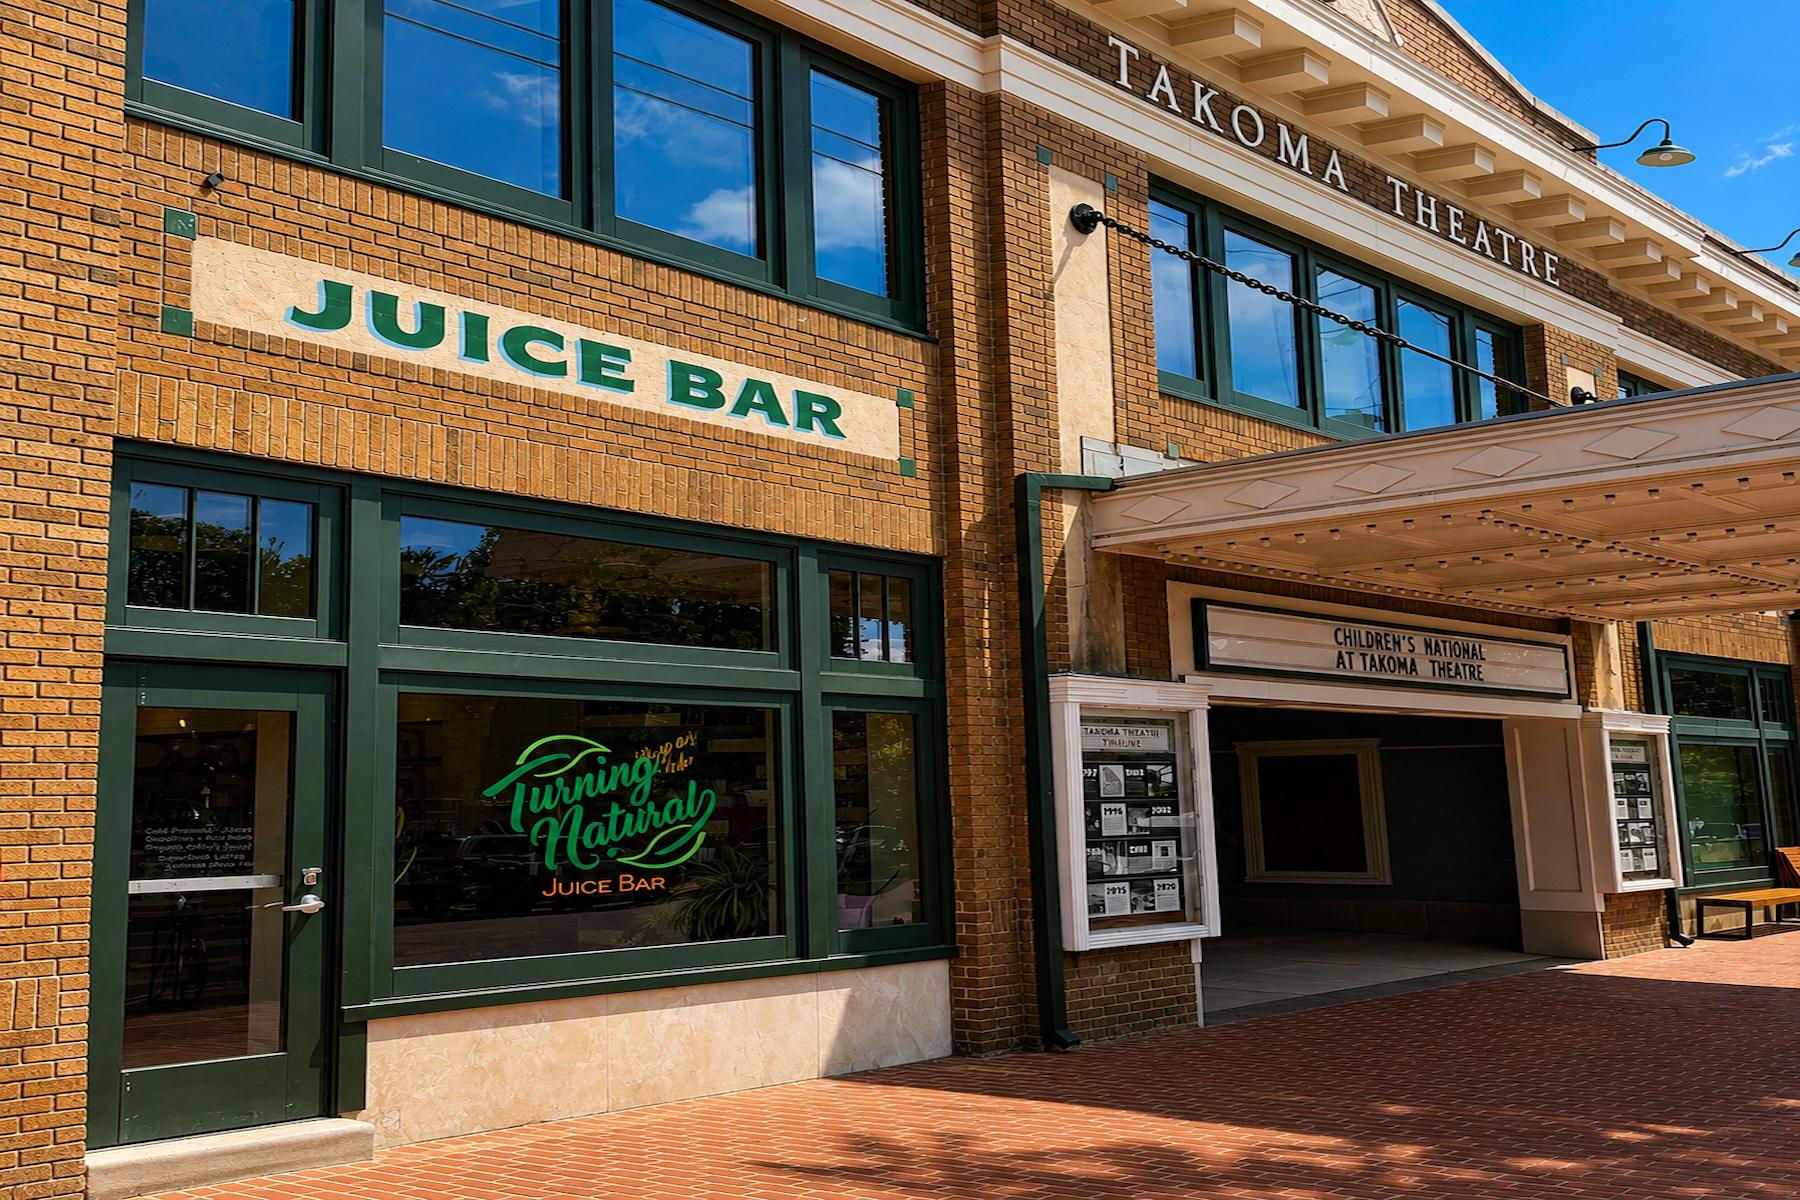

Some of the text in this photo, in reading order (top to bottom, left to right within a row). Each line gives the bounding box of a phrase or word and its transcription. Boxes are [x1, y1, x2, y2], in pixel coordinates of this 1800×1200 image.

[1107, 35, 1561, 287] TAKOMA THEATRE
[285, 279, 847, 440] JUICE BAR
[1334, 627, 1486, 661] CHILDREN'S NATIONAL
[1336, 651, 1484, 682] AT TAKOMA THEATRE
[483, 753, 660, 833] Turning
[530, 780, 717, 870] Natural
